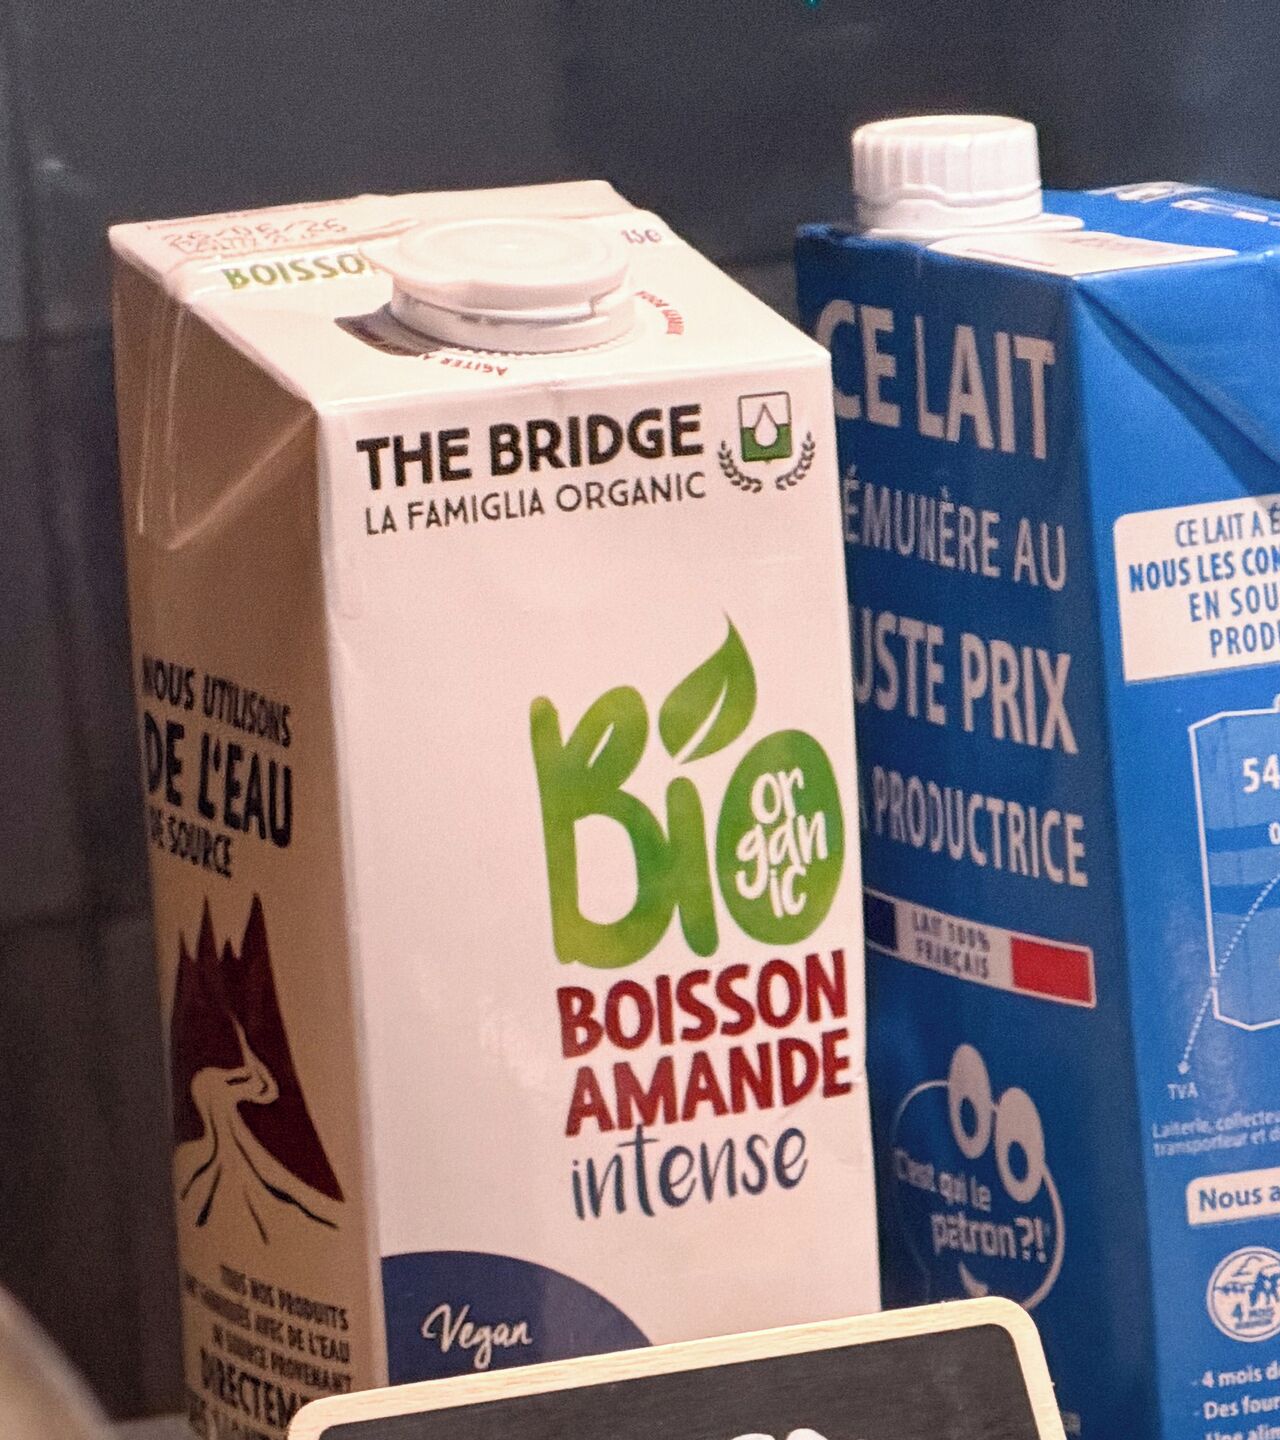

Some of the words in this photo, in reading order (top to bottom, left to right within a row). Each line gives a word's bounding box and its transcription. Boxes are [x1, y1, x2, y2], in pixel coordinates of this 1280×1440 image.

[222, 253, 378, 290] BOISSO
[817, 298, 900, 428] CE
[914, 315, 1056, 460] LAIT
[356, 428, 473, 491] THE
[489, 404, 704, 476] BRIDGE
[365, 507, 398, 536] LA
[408, 487, 546, 531] FAMIGLIA
[556, 471, 707, 513] ORGANIC
[843, 463, 1000, 578] ÉMUNÈRE
[1013, 517, 1067, 592] AU
[1175, 518, 1198, 550] CE
[1203, 512, 1246, 546] LAIT
[1251, 514, 1265, 539] A
[1128, 560, 1192, 594] NOUS
[1198, 550, 1236, 585] LES
[1188, 588, 1221, 624] EN
[142, 654, 197, 711] NOUS
[850, 600, 946, 726] USTE
[961, 631, 1079, 755] PRIX
[144, 709, 186, 807] DE
[197, 732, 293, 849] L'EAU
[872, 765, 1088, 888] PRODUCTRICE
[556, 948, 849, 1059] BOISSON
[565, 1028, 853, 1137] AMANDE
[571, 1124, 808, 1221] intense
[1198, 1186, 1264, 1212] Nous
[421, 1303, 533, 1369] Vegan
[201, 1347, 312, 1431] DIRECTEM
[1202, 1369, 1214, 1388] 4
[1218, 1366, 1263, 1388] mois
[1203, 1400, 1239, 1420] Des
